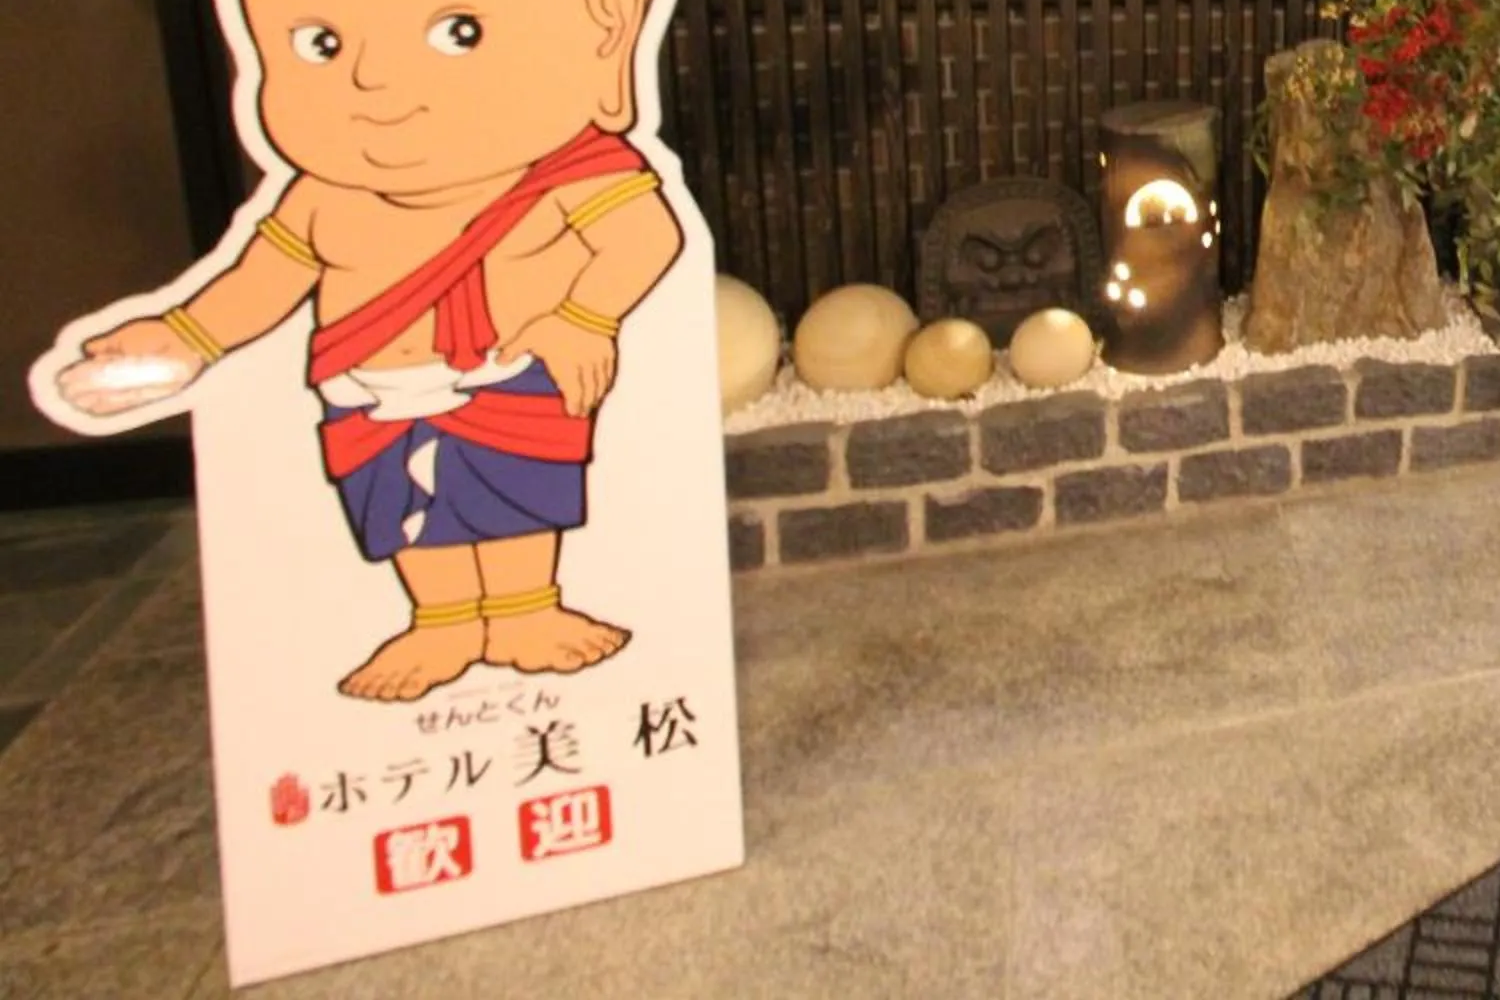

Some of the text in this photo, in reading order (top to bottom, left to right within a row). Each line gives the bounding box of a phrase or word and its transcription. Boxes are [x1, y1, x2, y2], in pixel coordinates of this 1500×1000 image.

[414, 689, 560, 733] せんとくん
